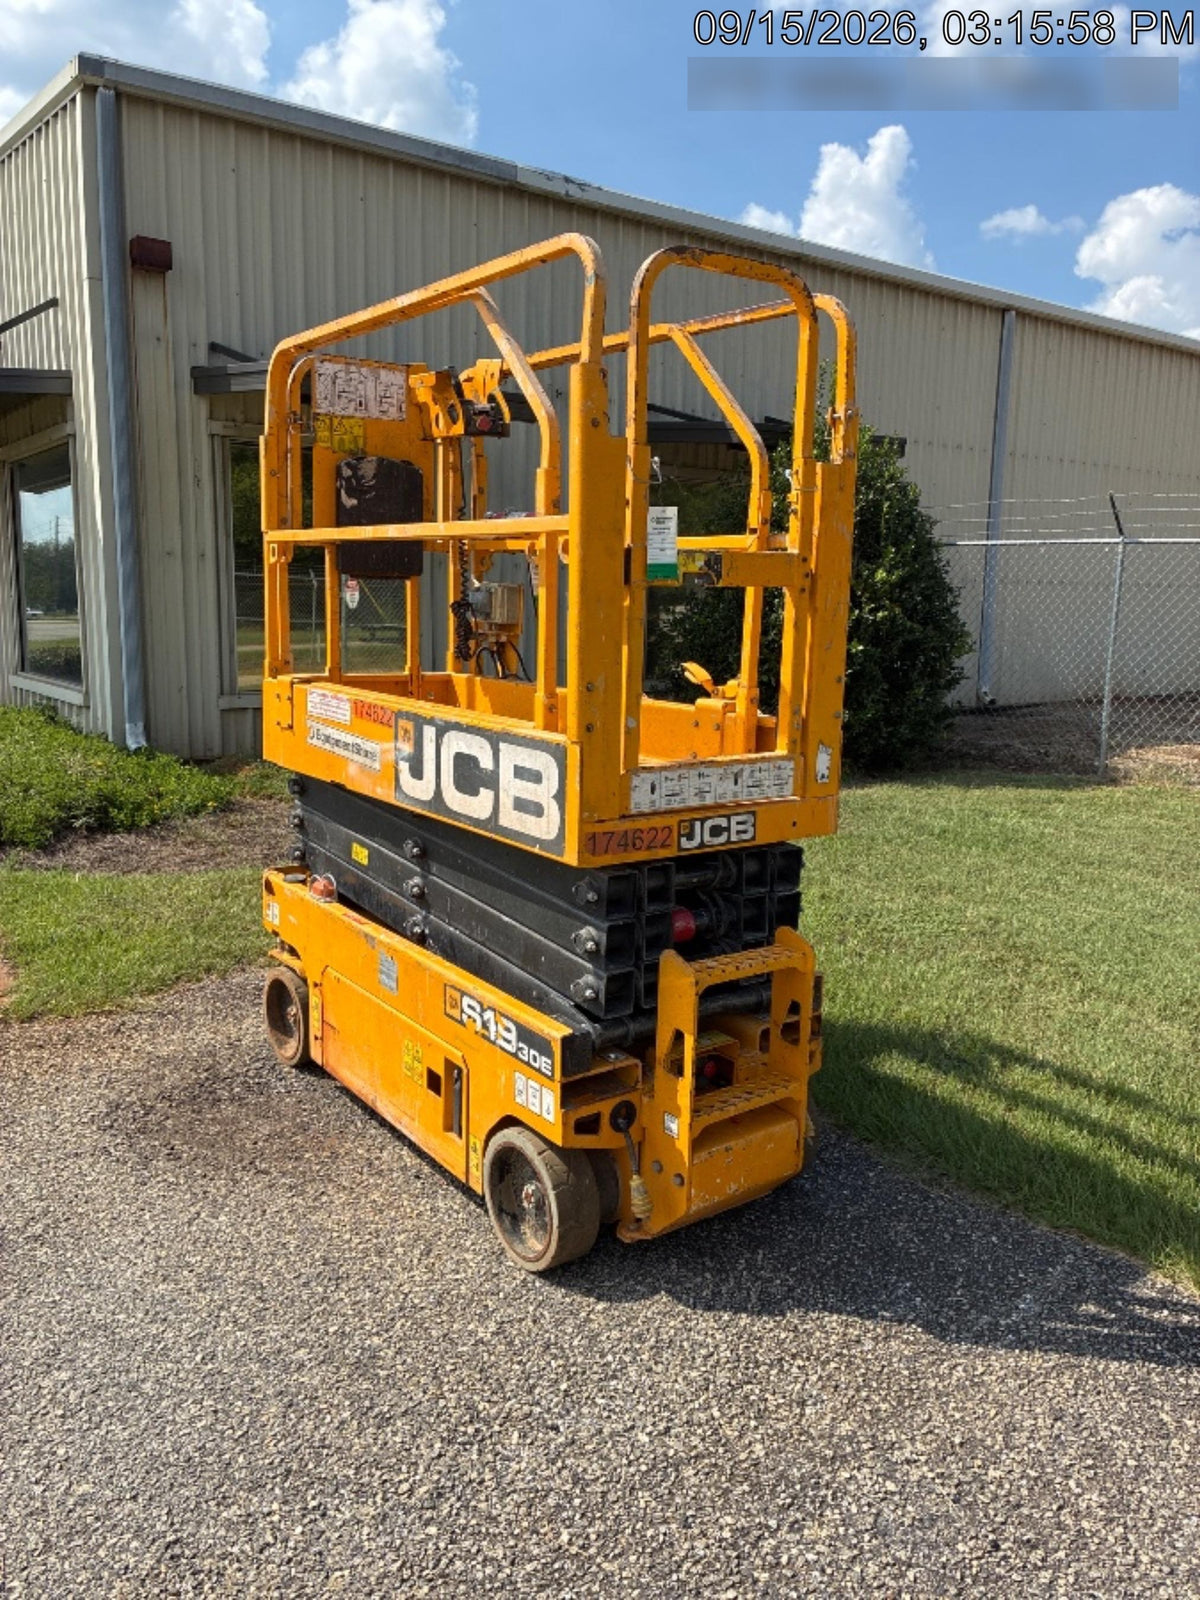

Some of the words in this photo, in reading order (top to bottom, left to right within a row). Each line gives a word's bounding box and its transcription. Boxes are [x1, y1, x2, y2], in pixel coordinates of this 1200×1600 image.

[353, 699, 394, 728] 174622
[398, 724, 561, 840] JCB
[587, 826, 673, 854] 174622
[679, 813, 755, 850] JCB
[517, 1041, 552, 1077] 30E
